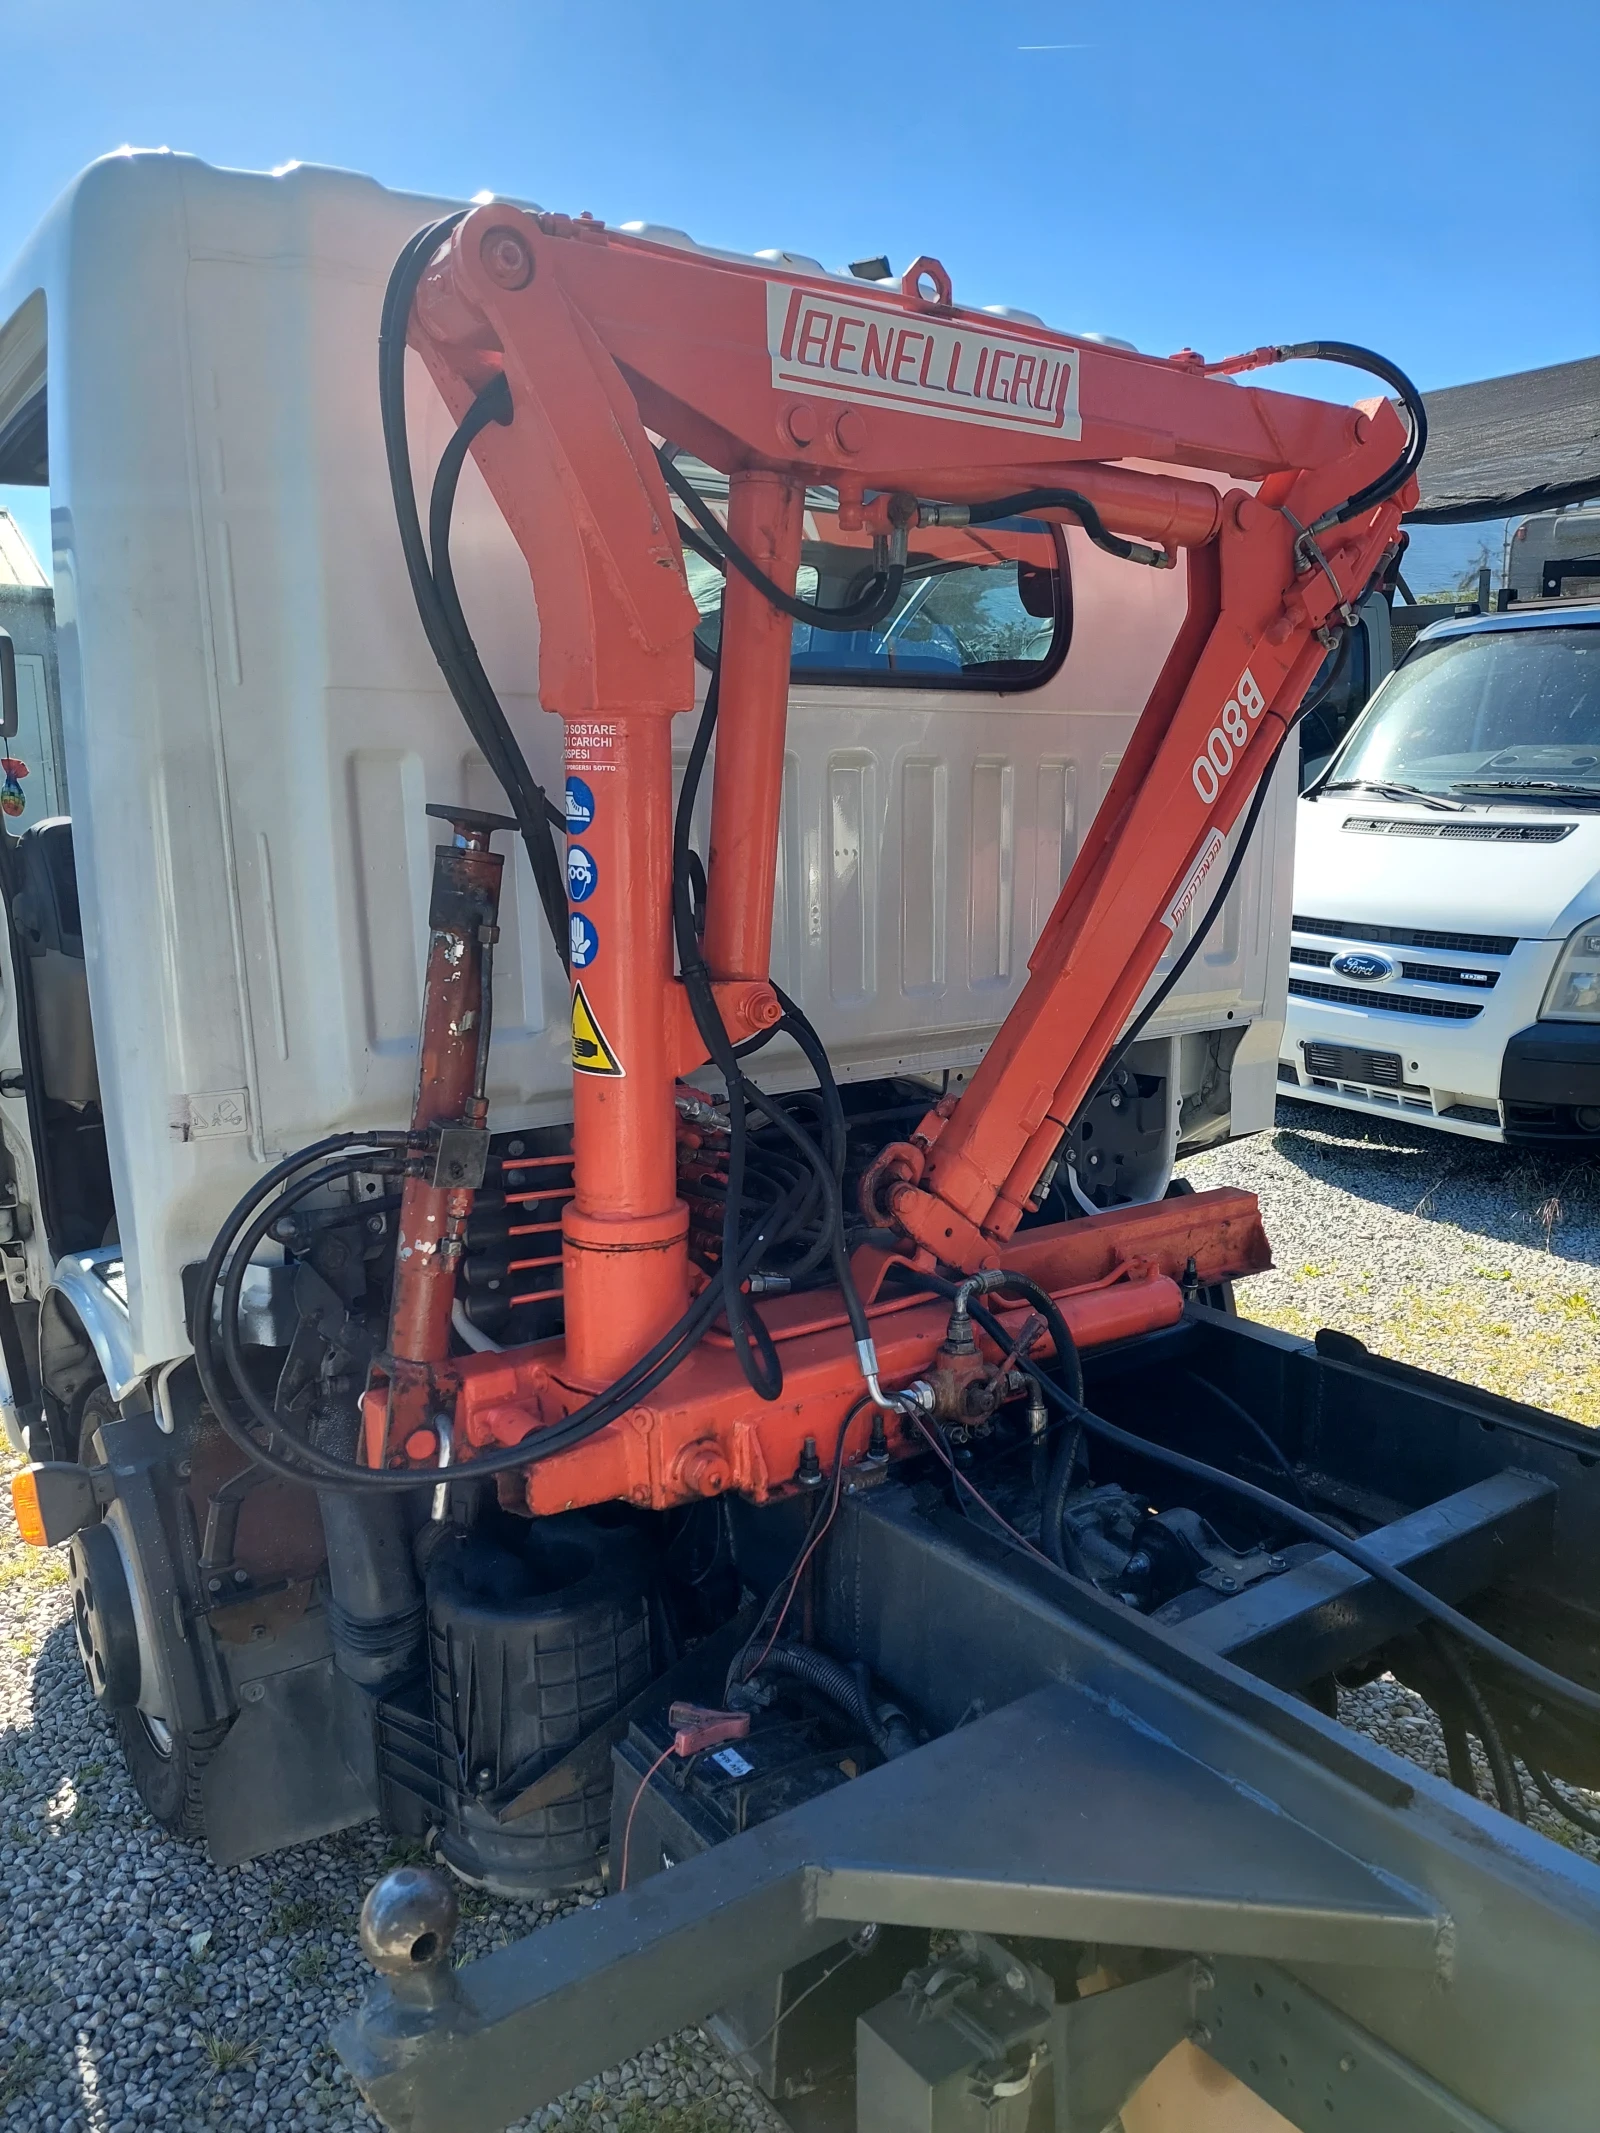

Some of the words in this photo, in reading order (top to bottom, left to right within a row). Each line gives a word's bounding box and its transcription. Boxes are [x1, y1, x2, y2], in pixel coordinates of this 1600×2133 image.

[798, 309, 1060, 411] BENELLIGRU
[570, 725, 616, 735] SOSTARE
[1192, 667, 1265, 804] B800
[571, 737, 612, 747] CARICHI
[1343, 957, 1375, 975] Ford
